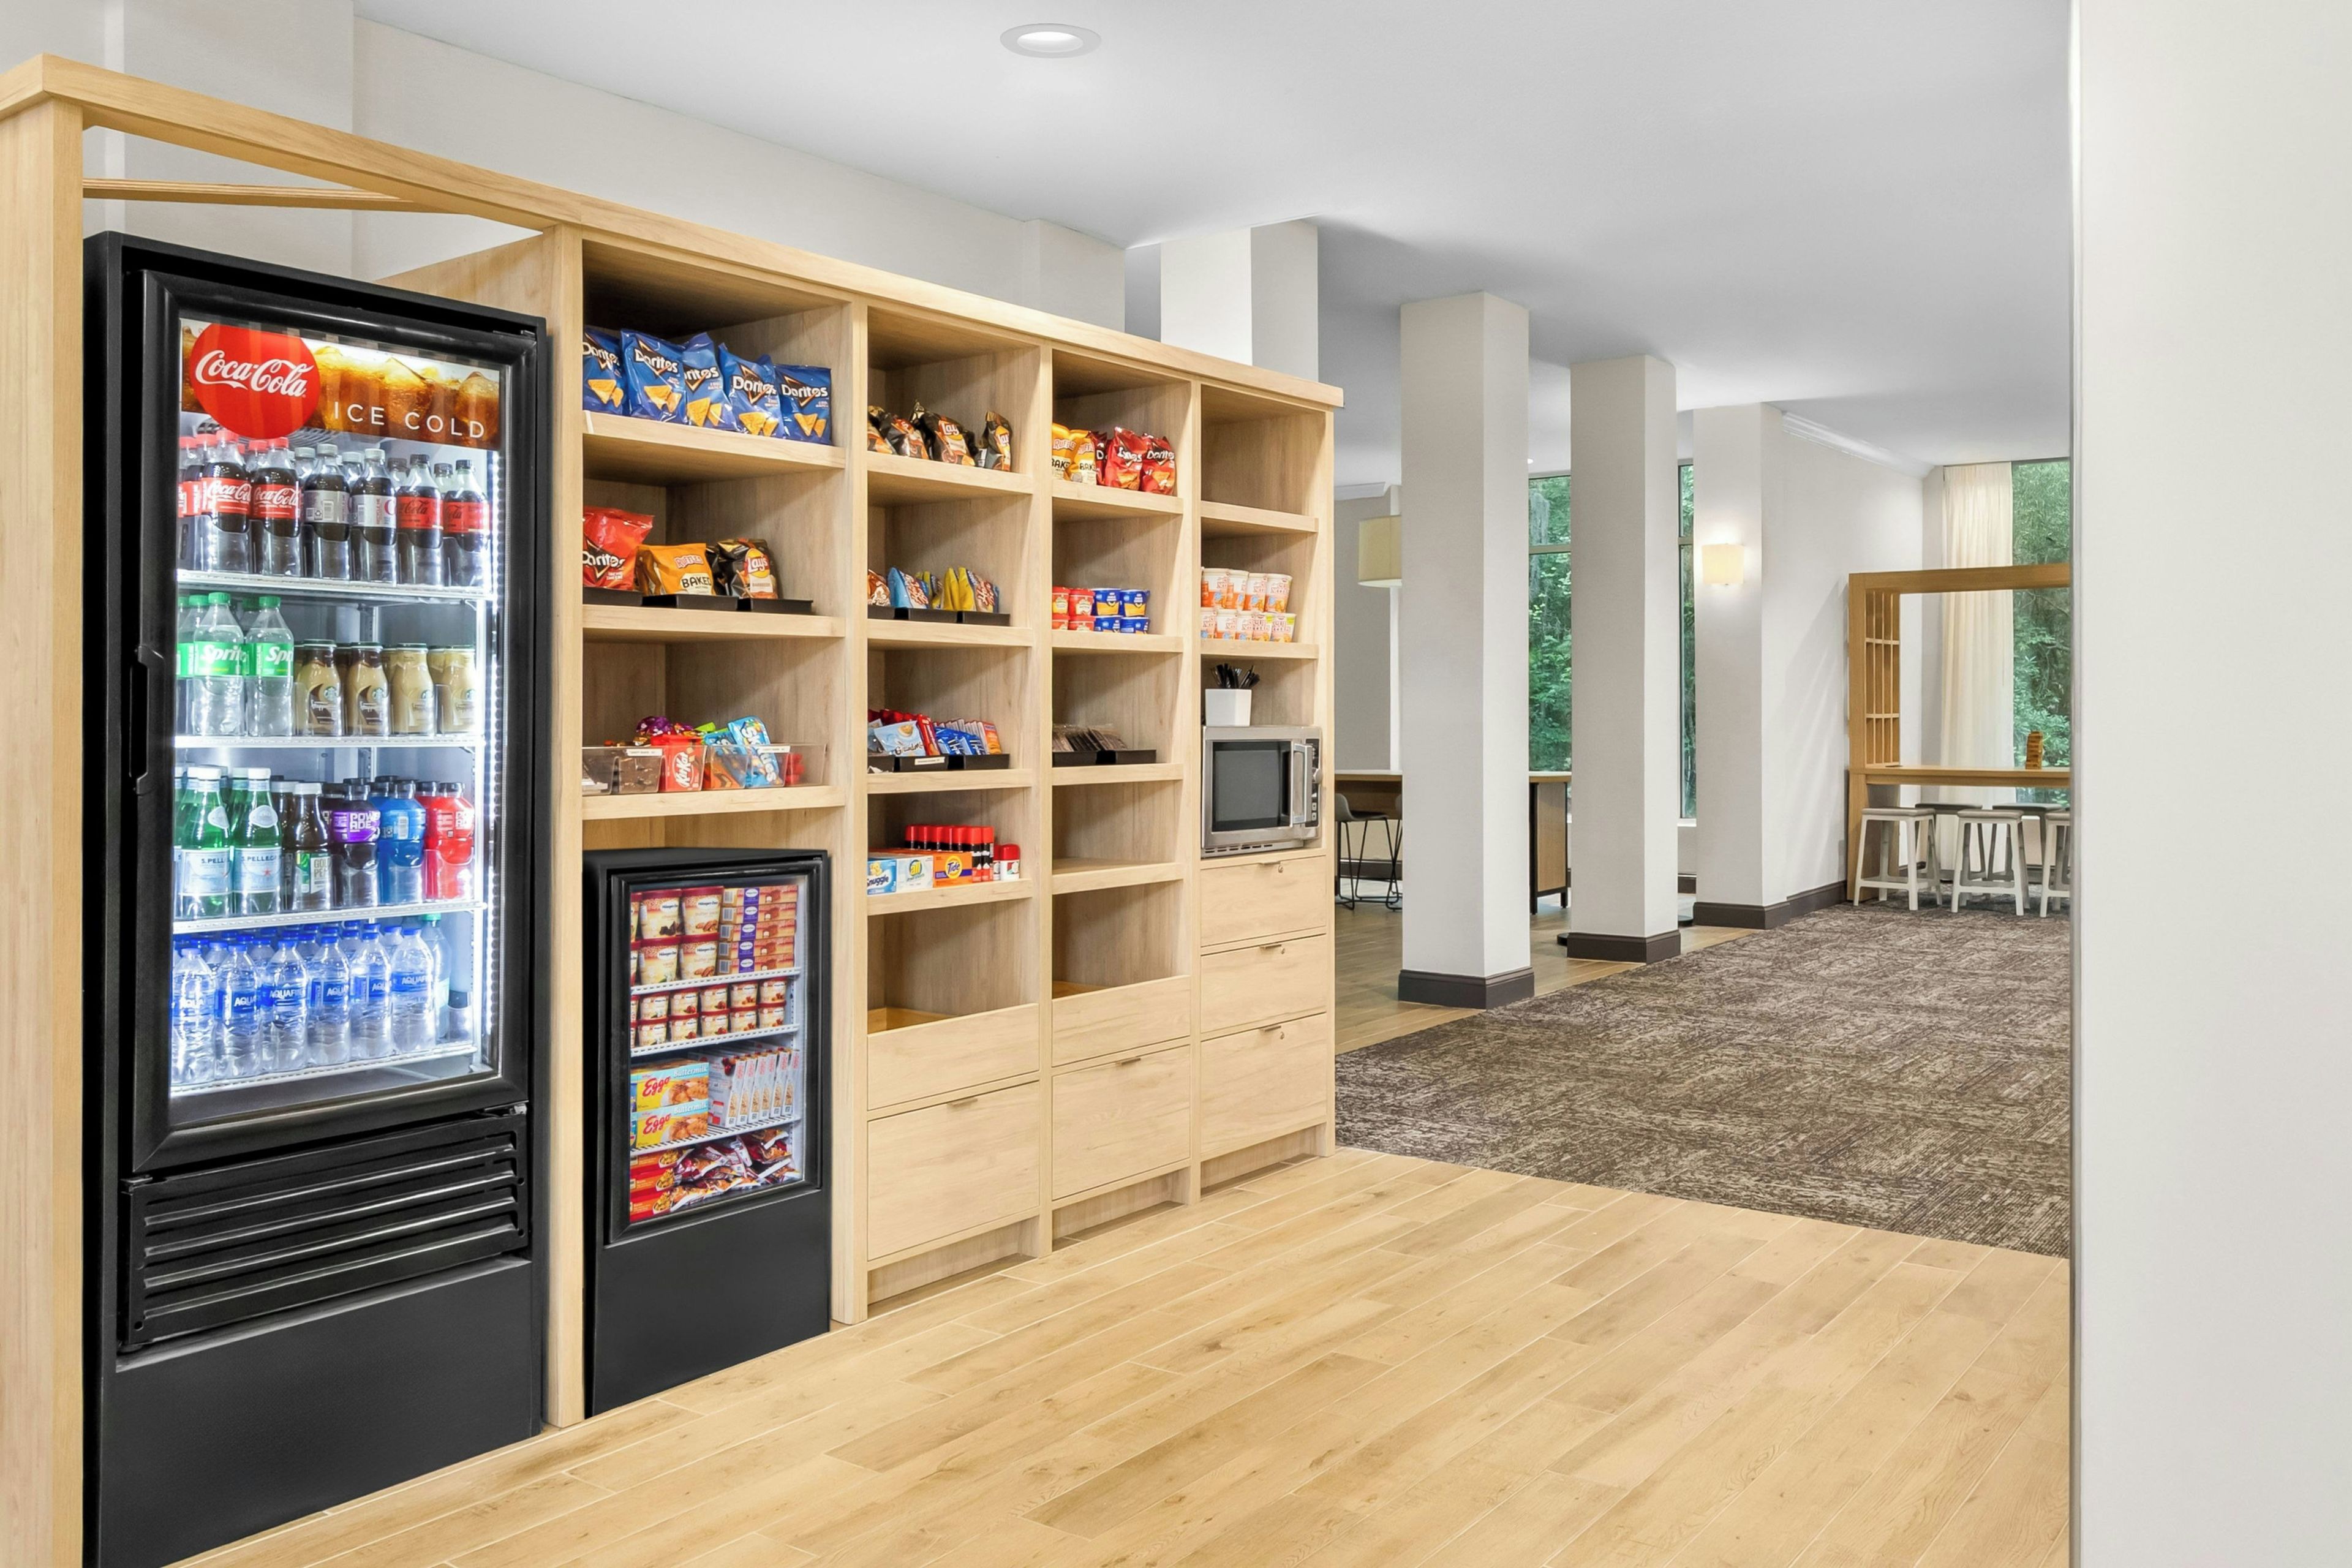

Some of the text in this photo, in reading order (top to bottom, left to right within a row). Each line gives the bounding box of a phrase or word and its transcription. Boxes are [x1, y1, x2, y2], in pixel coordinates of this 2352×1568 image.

[635, 349, 678, 373] Doritos
[195, 350, 314, 398] Coca-Cola
[684, 367, 719, 380] ritos
[781, 384, 828, 397] Doritos
[334, 401, 484, 439] ICE COLD
[747, 556, 769, 573] Lay's
[948, 861, 960, 875] Tide
[674, 1066, 707, 1077] Buttermilk
[643, 1076, 671, 1097] Eggo
[643, 1113, 671, 1134] Eggo
